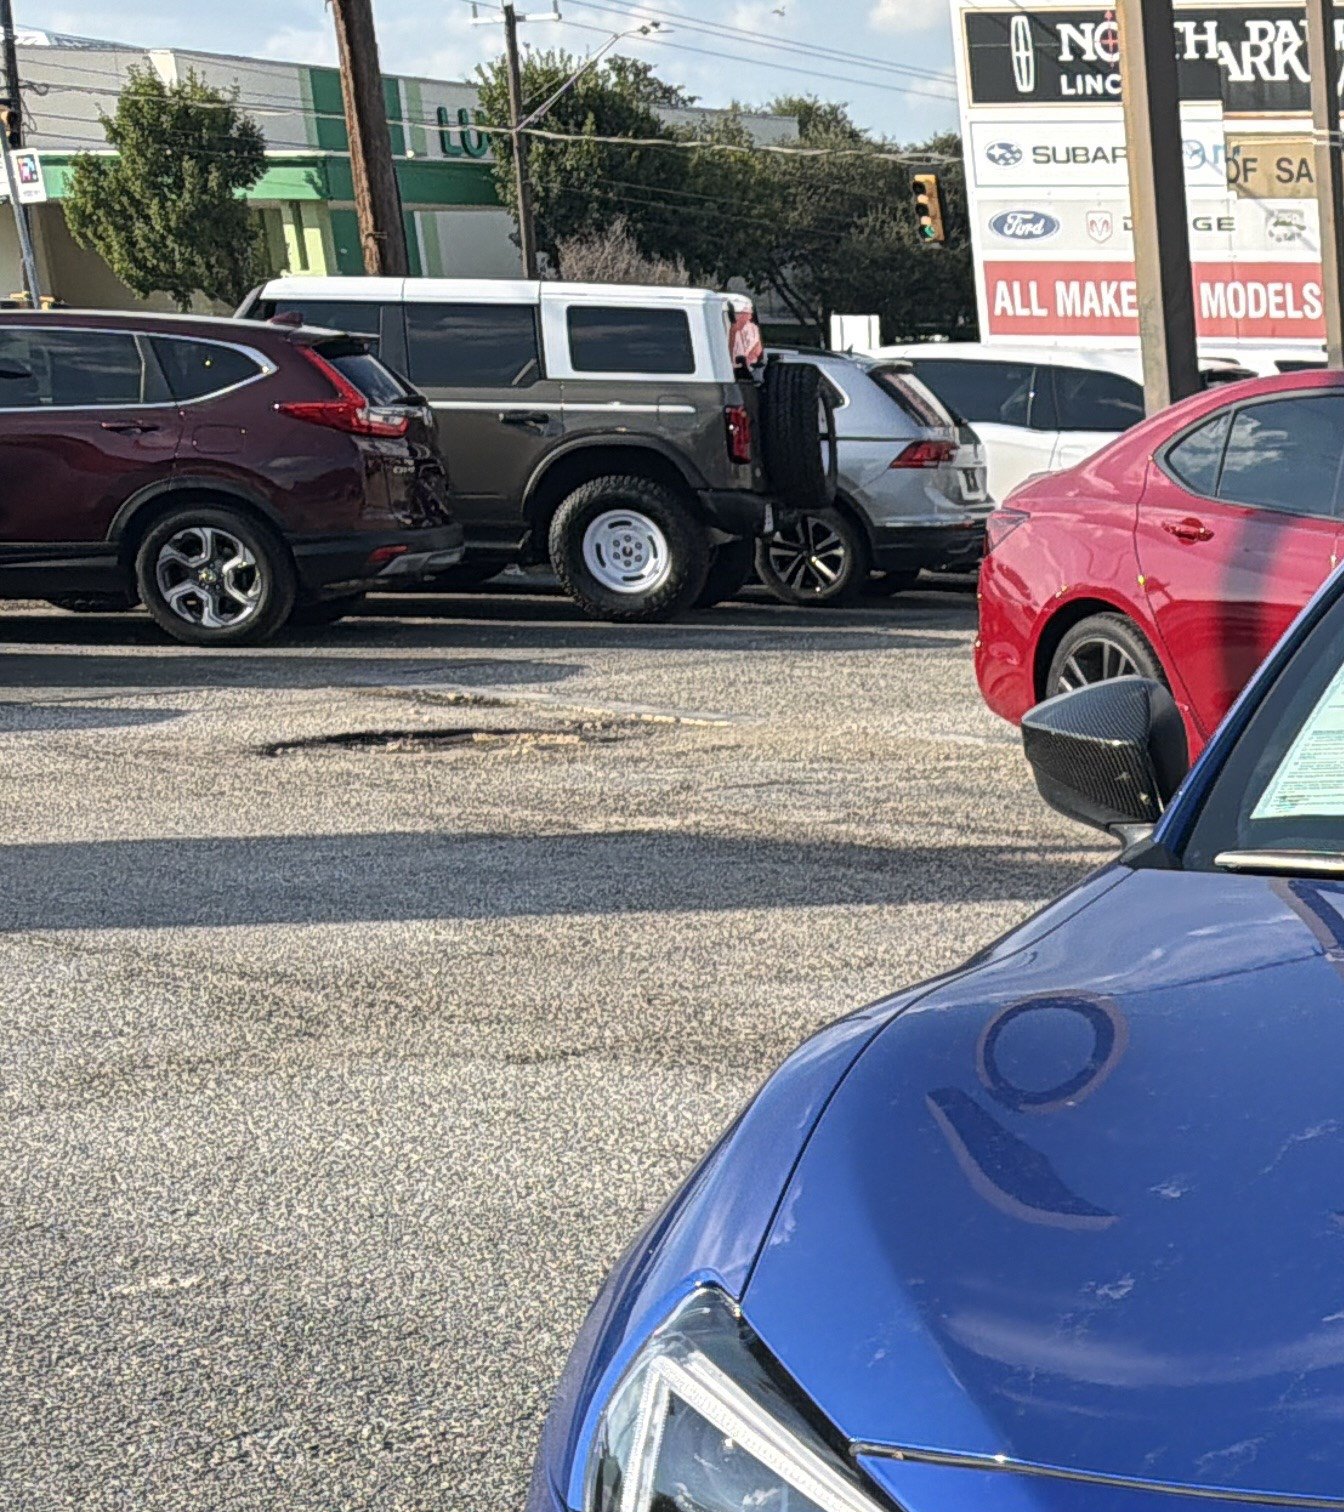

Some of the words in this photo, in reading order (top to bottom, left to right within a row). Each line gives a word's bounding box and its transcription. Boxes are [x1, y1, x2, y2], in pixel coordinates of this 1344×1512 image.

[1056, 21, 1218, 62] NOH
[1032, 146, 1127, 164] SUBAR
[1276, 157, 1314, 184] SA
[1002, 212, 1045, 237] Ford
[994, 280, 1048, 317] ALL
[1055, 280, 1138, 318] MAKE
[1200, 281, 1322, 320] MODELS
